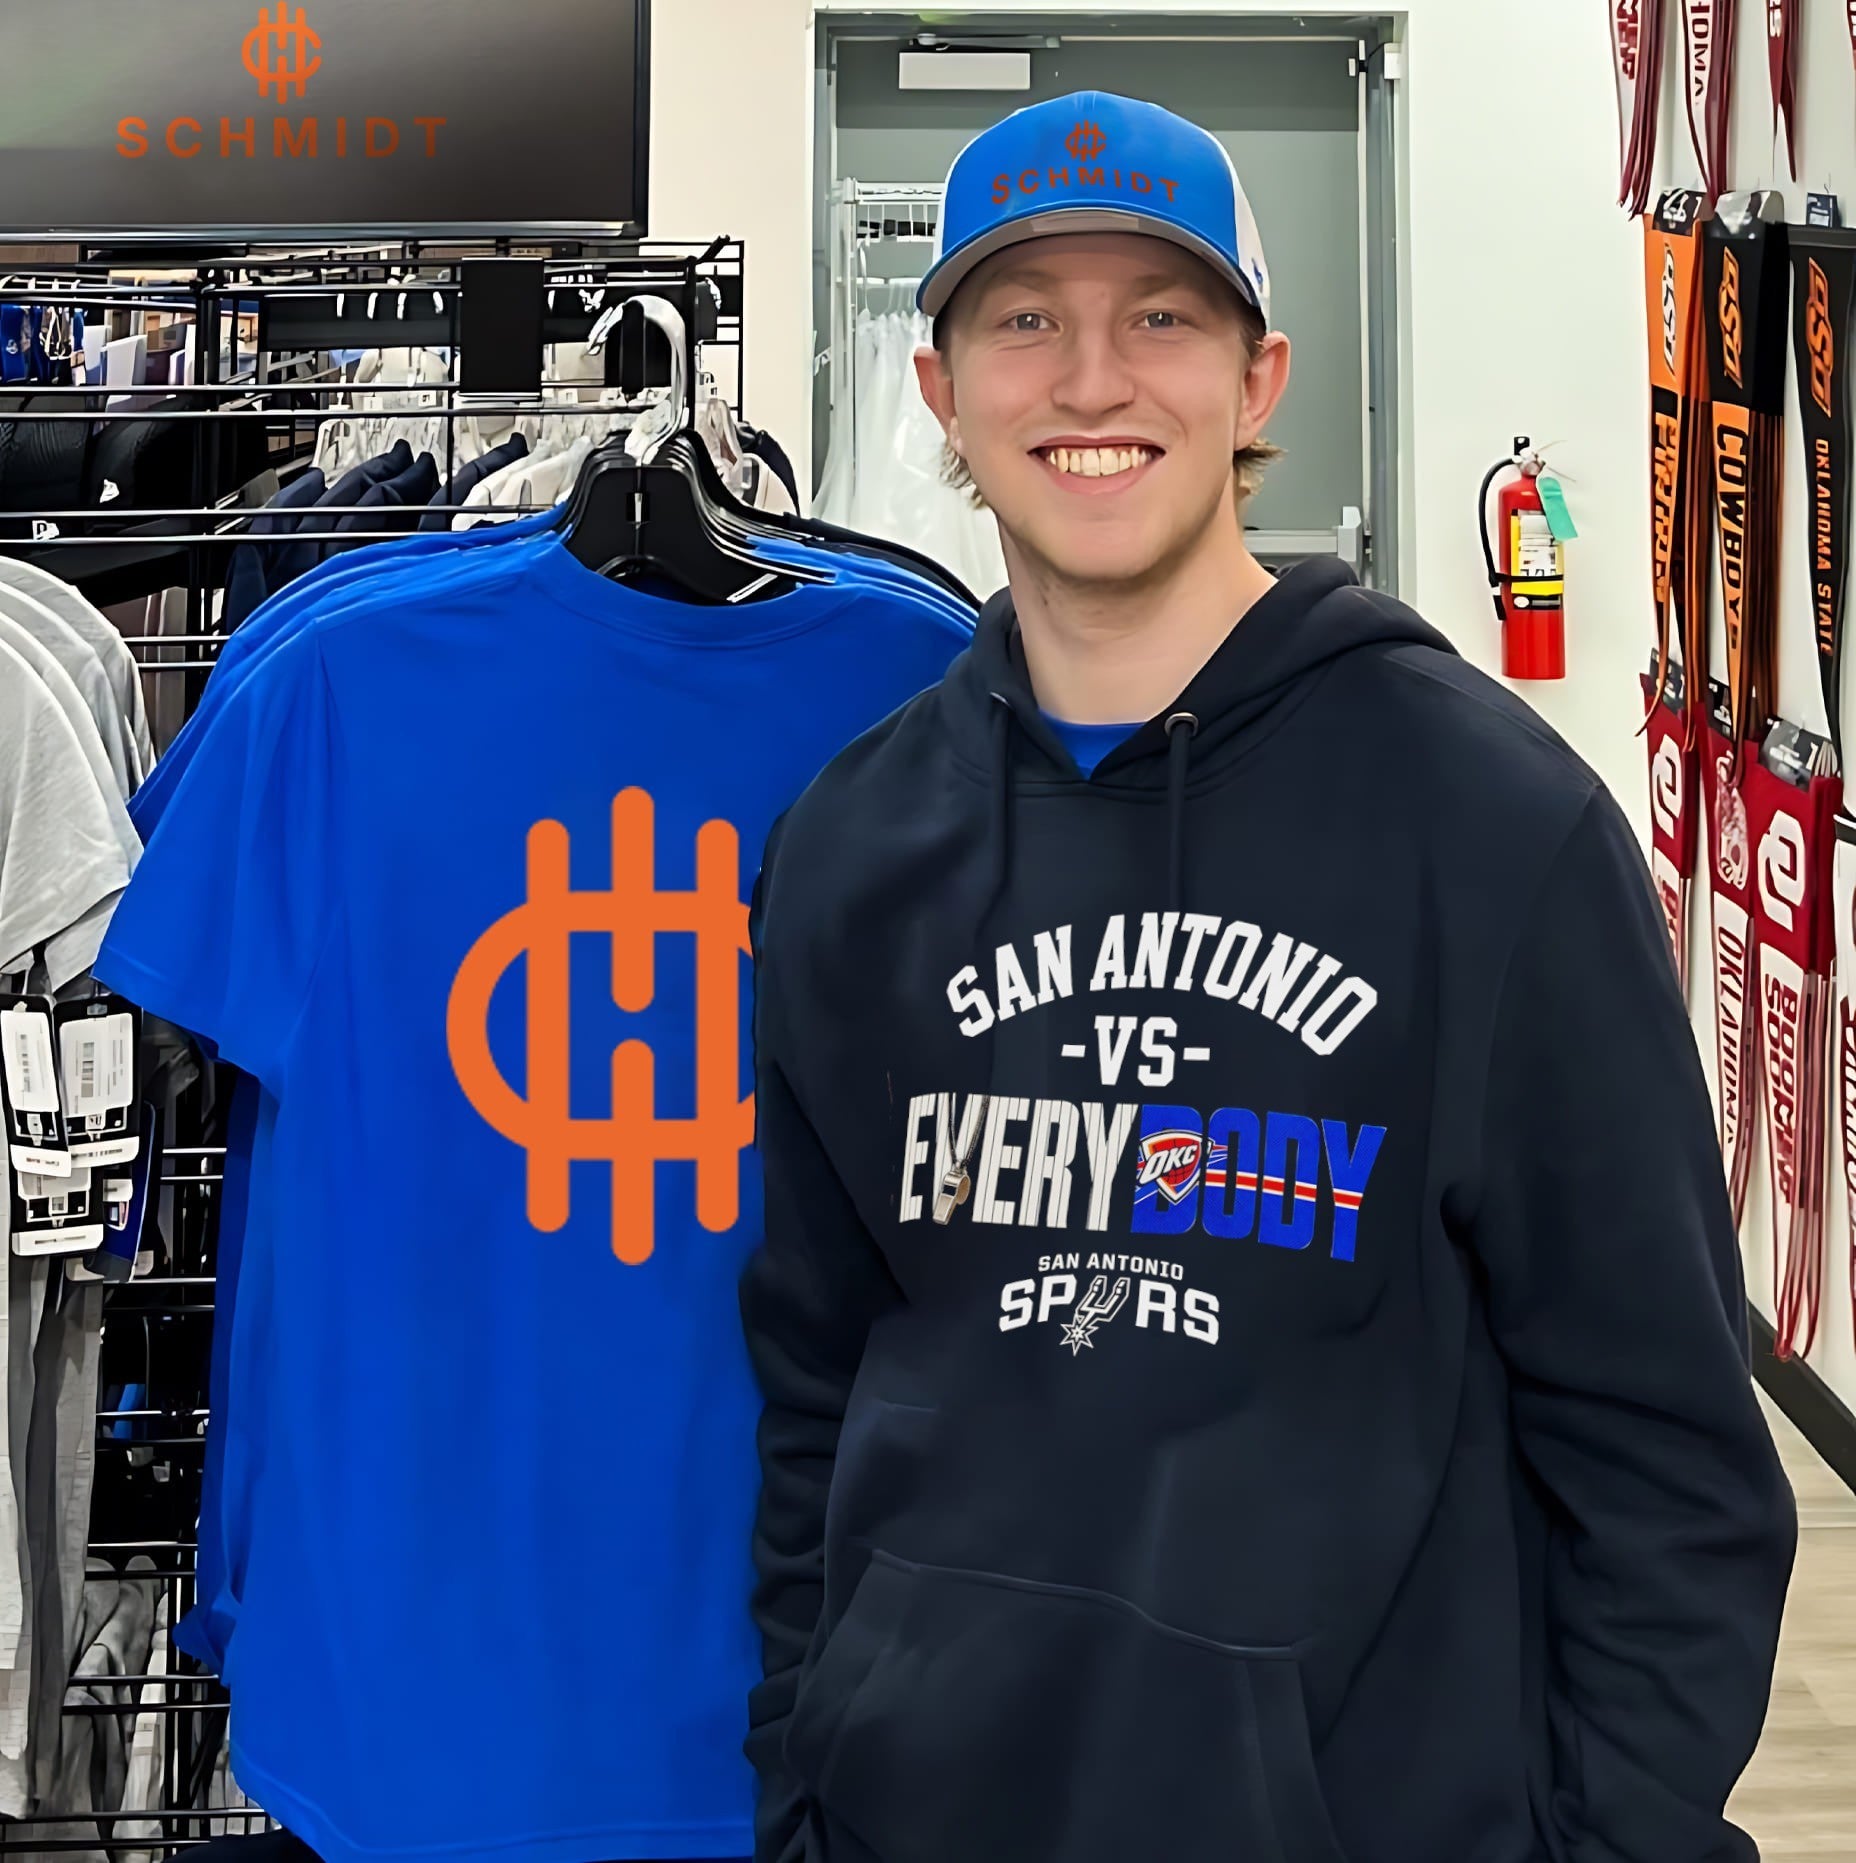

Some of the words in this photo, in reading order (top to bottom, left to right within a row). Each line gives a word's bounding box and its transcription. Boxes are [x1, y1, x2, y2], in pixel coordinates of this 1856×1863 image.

[115, 116, 447, 159] SCHMIDT
[991, 166, 1179, 205] SCHMIDT
[946, 924, 1073, 1037] SAN
[1089, 911, 1378, 1056] ANTONIO
[1139, 1144, 1199, 1185] OKC
[1038, 1253, 1079, 1272] SAN
[1086, 1253, 1184, 1281] ANTONIO
[999, 1274, 1220, 1357] SPURS
